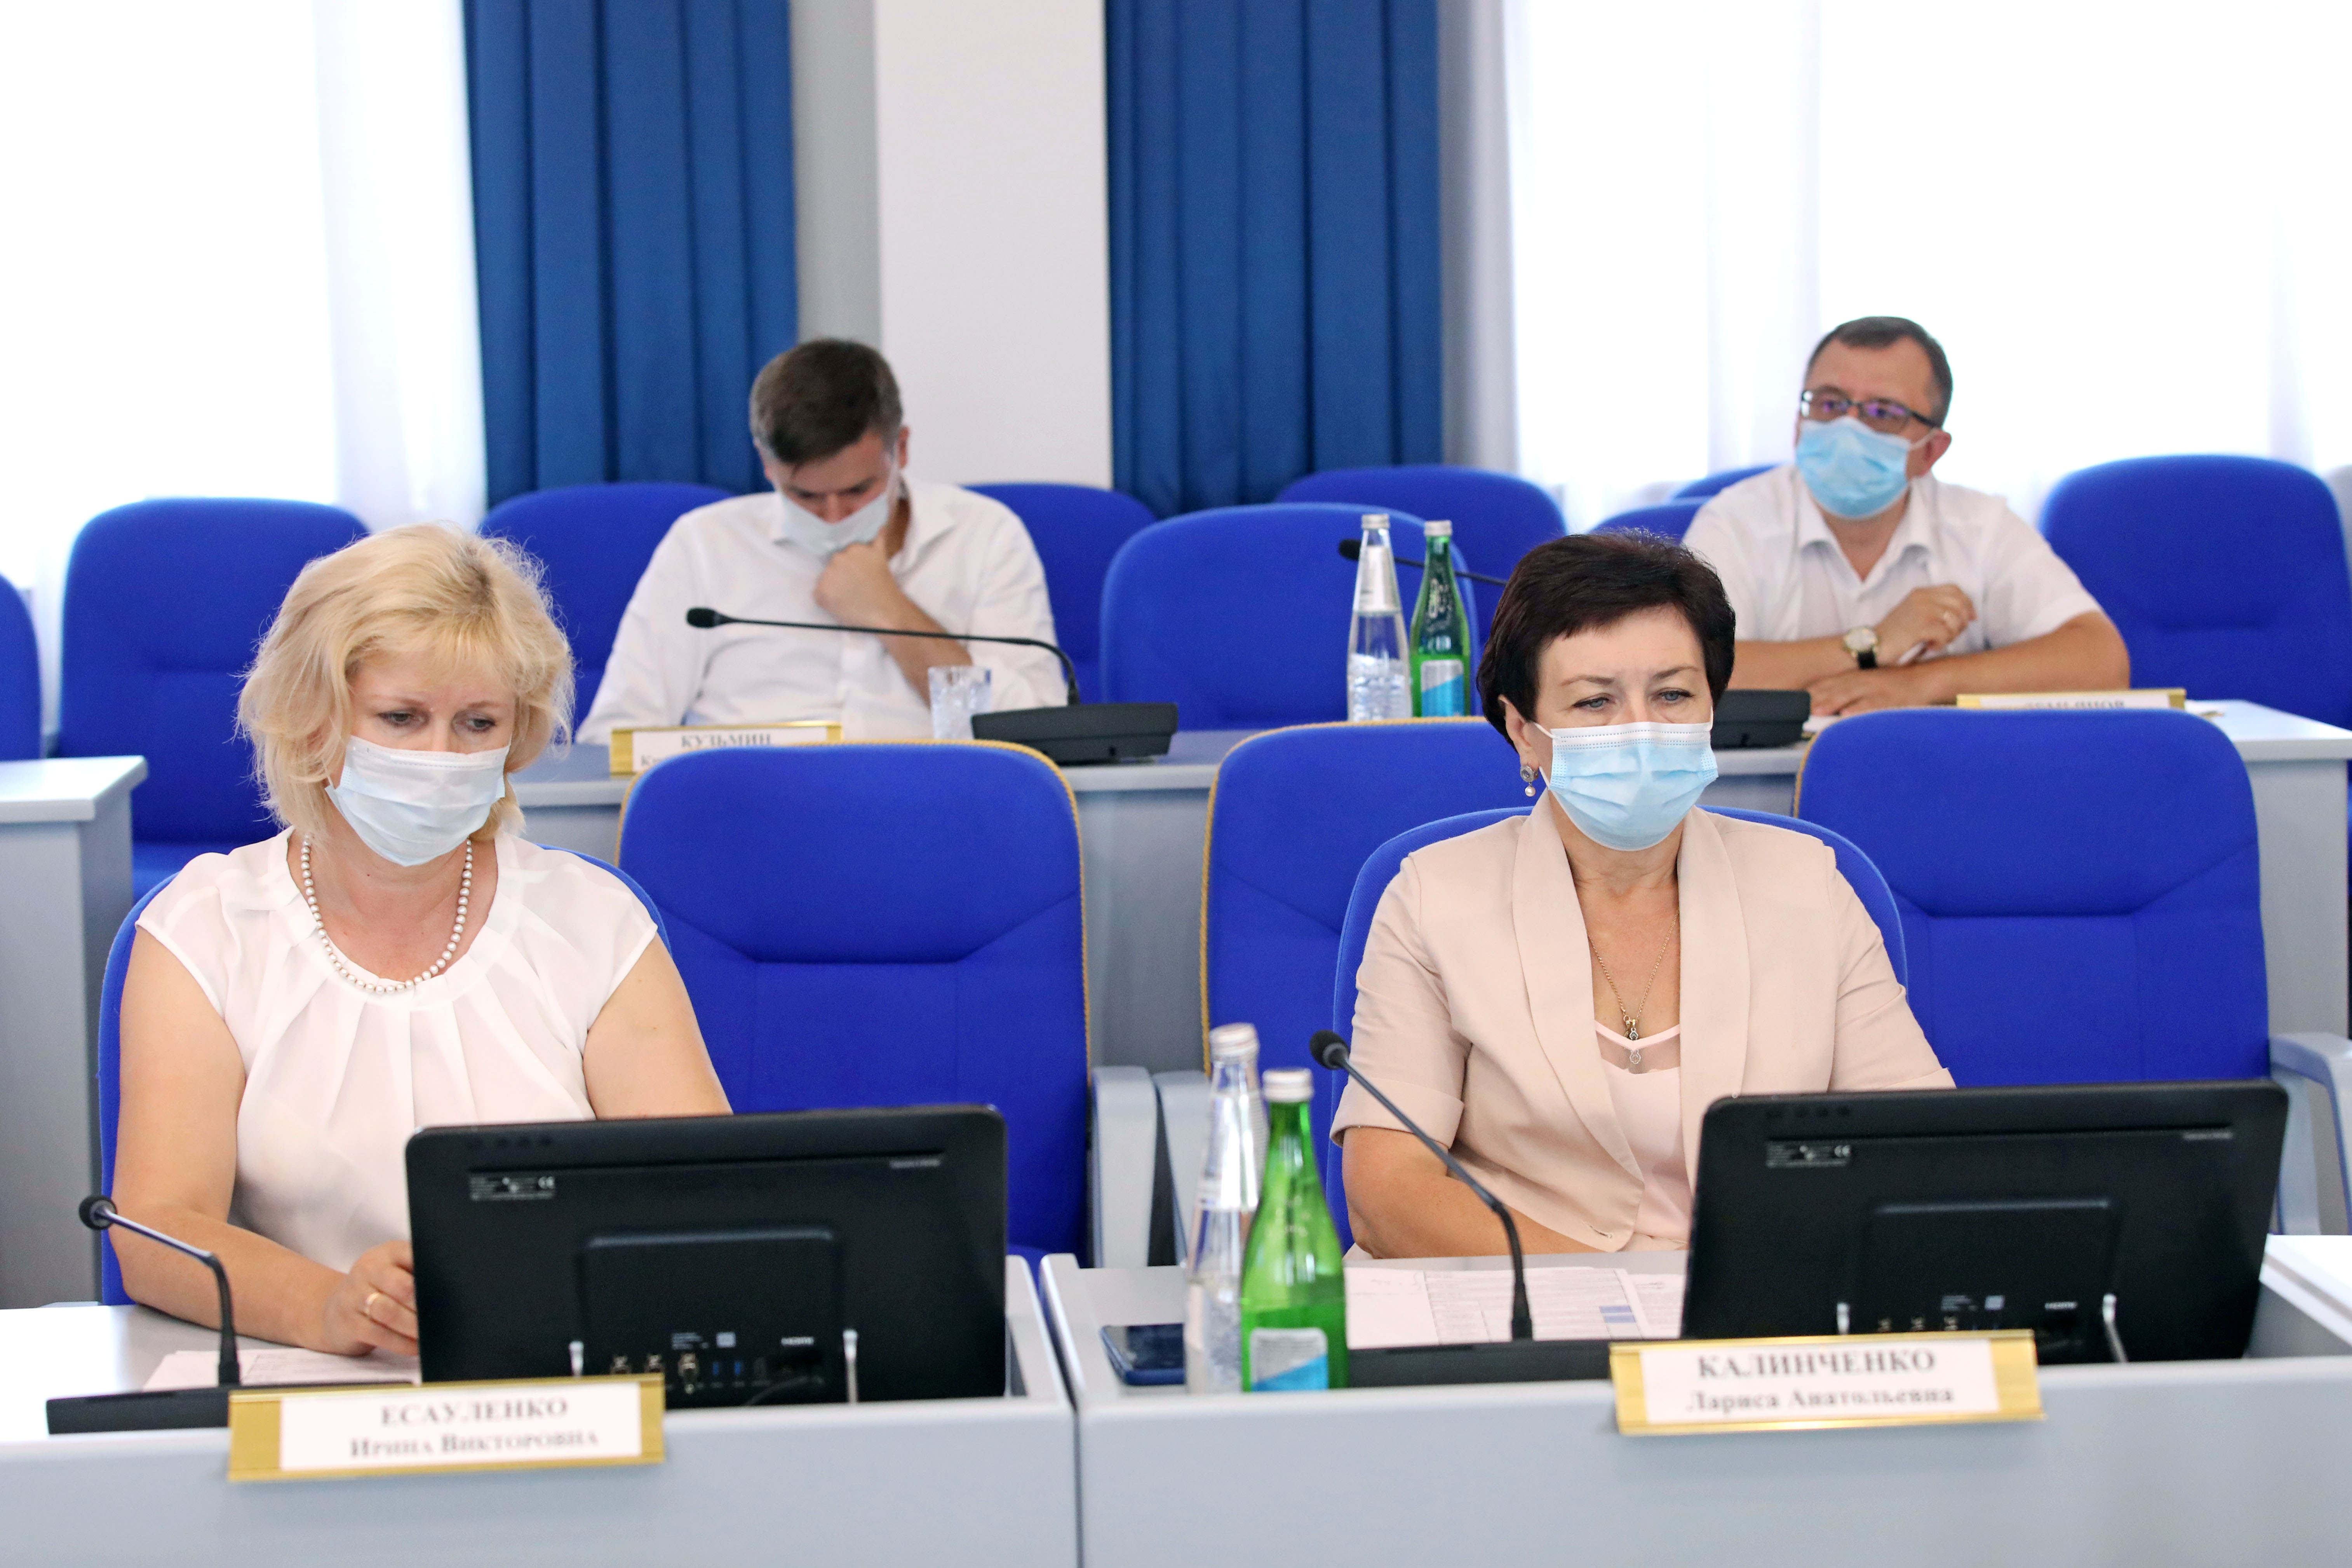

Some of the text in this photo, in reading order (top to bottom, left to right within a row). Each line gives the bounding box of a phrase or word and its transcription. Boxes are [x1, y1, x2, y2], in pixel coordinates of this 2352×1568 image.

[1698, 1349, 1934, 1377] КАЛИНЧЕНКО
[381, 1397, 568, 1425] ЕСАУЛЕНКО
[1687, 1388, 1953, 1414] Лариса Анатольевна
